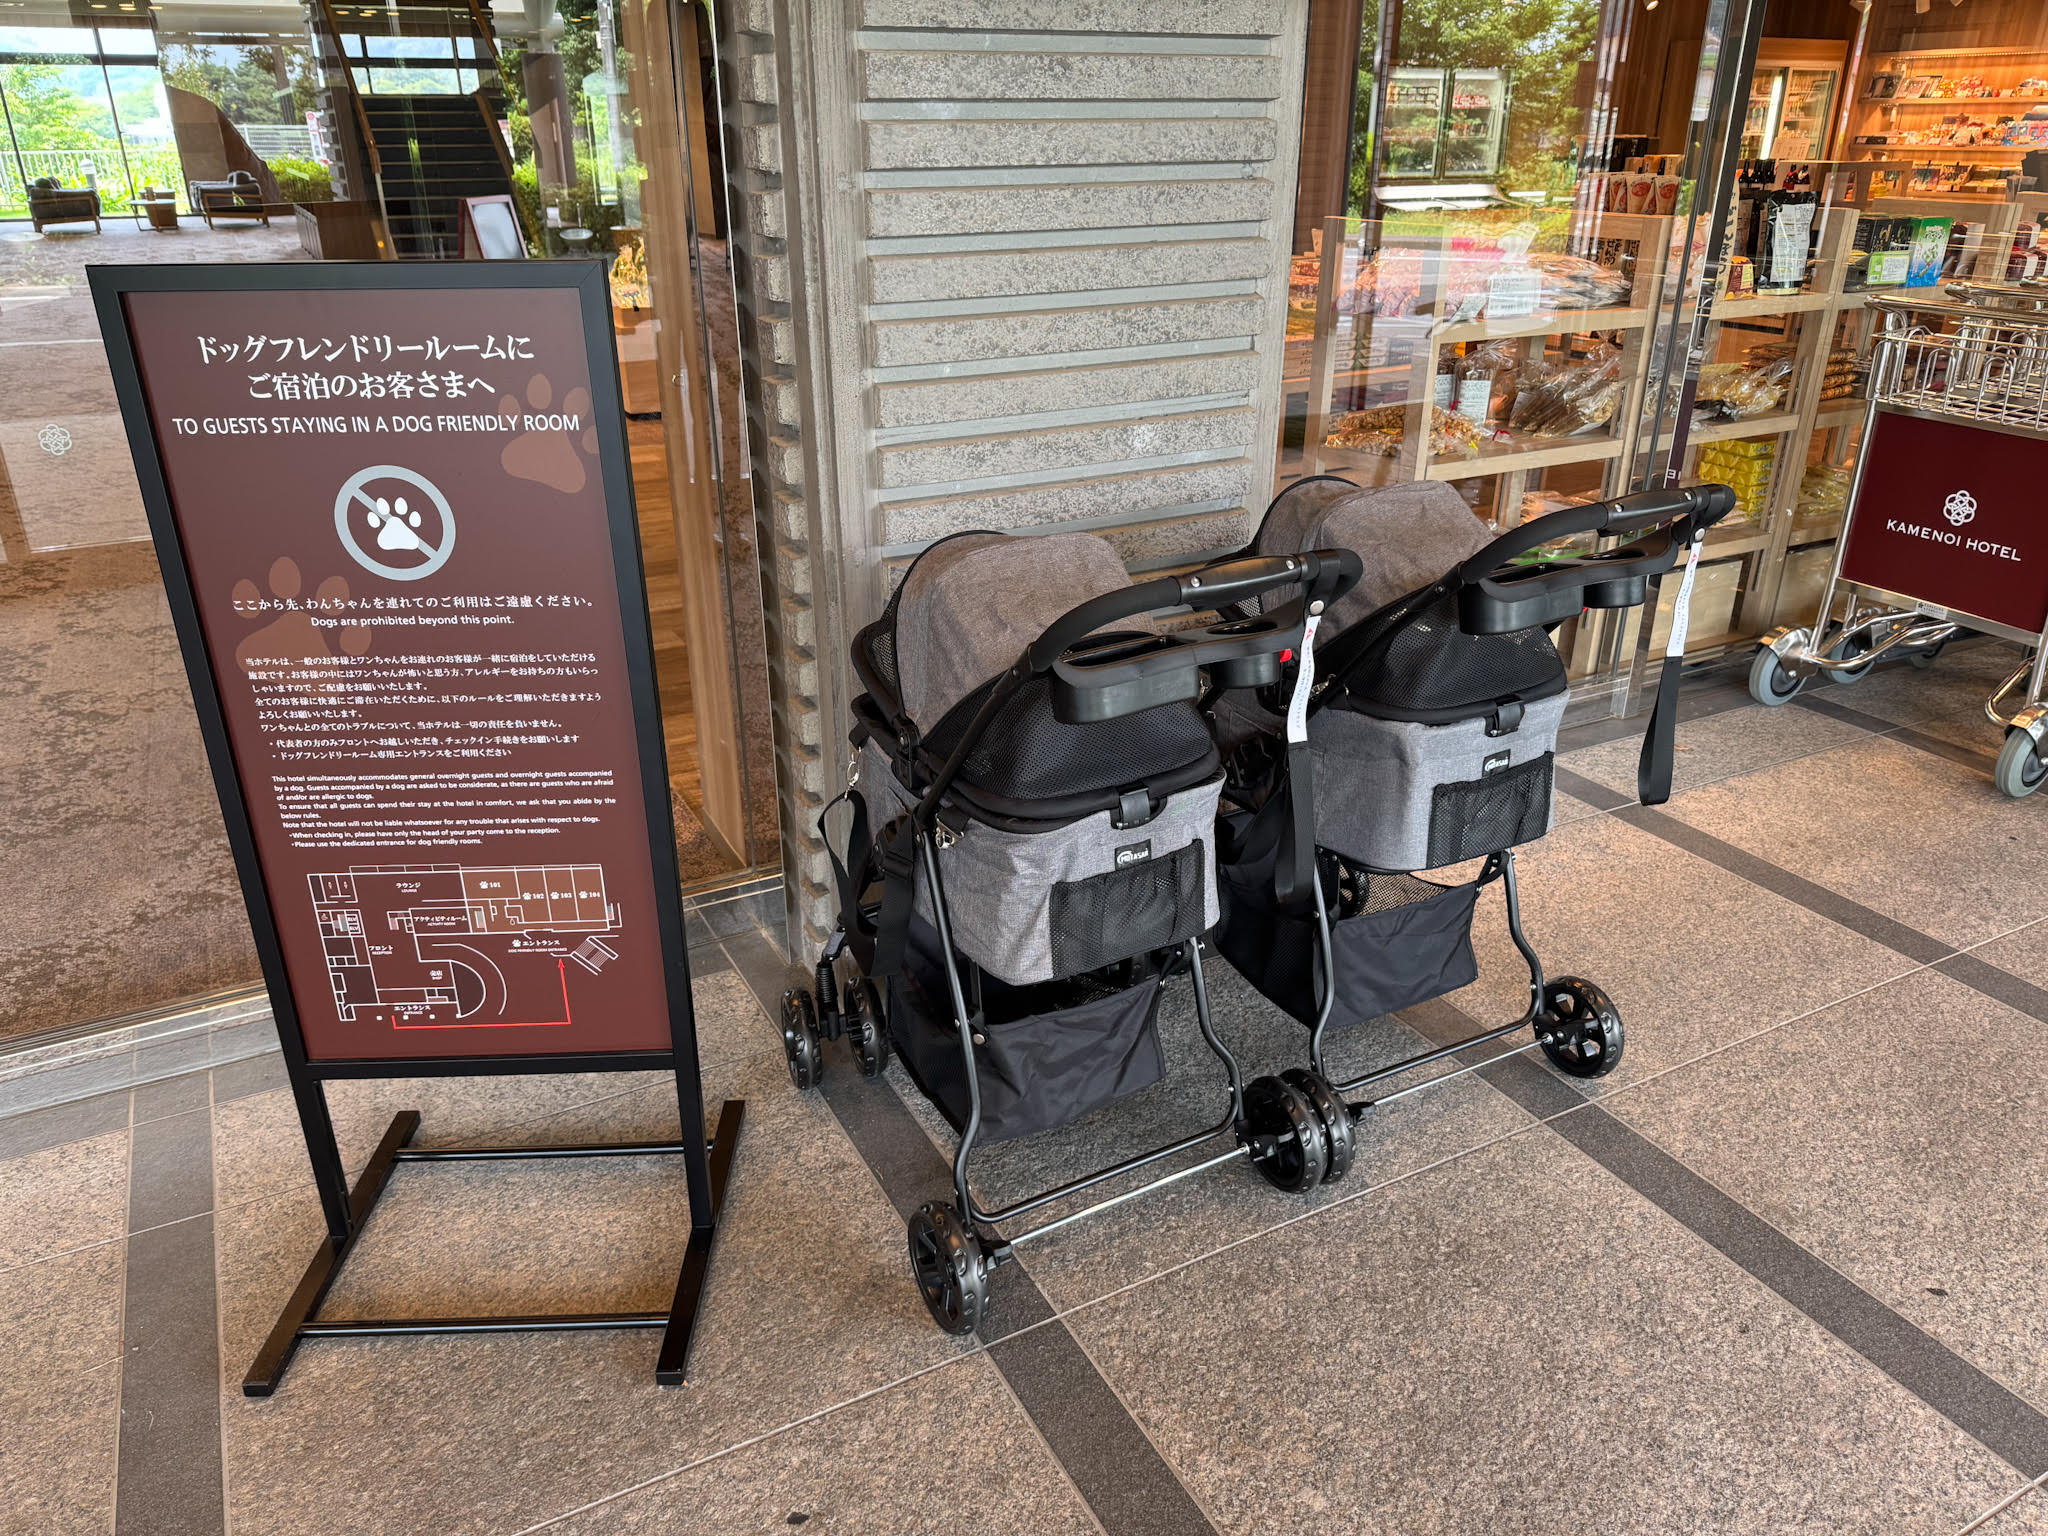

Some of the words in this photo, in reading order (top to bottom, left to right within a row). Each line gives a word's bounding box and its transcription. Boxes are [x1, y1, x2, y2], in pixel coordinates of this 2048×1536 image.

[197, 334, 535, 364] ドッグフレンドリールームに
[247, 371, 496, 400] ご宿泊のお客さまへ
[171, 417, 199, 435] TO
[202, 416, 268, 435] GUESTS
[270, 415, 348, 434] STAYING
[350, 415, 370, 433] IN
[375, 415, 389, 433] A
[391, 414, 433, 433] DOG
[436, 414, 519, 432] FRIENDLY
[522, 413, 580, 432] ROOM
[1886, 518, 1962, 547] KAMENOI
[1965, 537, 2022, 562] HOTEL
[232, 595, 593, 611] ここから先、わんちゃんを連れてのご利用はご遠慮ください。
[310, 616, 338, 629] Dogs
[339, 617, 358, 626] are
[359, 615, 416, 628] prohibited
[417, 614, 458, 627] beyond
[459, 614, 481, 625] this
[482, 614, 515, 626] point.
[258, 709, 363, 720] よろしくお願いいたします。
[286, 774, 306, 782] hotel
[305, 774, 357, 783] simultaneously
[357, 773, 409, 781] accommodates
[408, 772, 436, 782] general
[436, 771, 470, 781] overnight
[470, 772, 494, 780] guests
[494, 771, 509, 779] and
[509, 770, 544, 779] overnight
[543, 770, 567, 779] guests
[567, 769, 613, 778] accompanied
[330, 782, 375, 792] accompanied
[390, 782, 406, 791] dog
[418, 781, 439, 789] asked
[508, 780, 528, 788] there
[540, 780, 564, 788] guests
[592, 778, 614, 786] afraid
[285, 793, 308, 801] and/or
[320, 792, 346, 802] allergic
[312, 802, 328, 810] that
[338, 802, 362, 811] guests
[376, 800, 398, 810] spend
[398, 800, 416, 808] their
[416, 801, 432, 809] stay
[455, 799, 475, 807] hotel
[528, 798, 541, 806] ask
[541, 797, 557, 805] that
[572, 797, 593, 805] abide
[603, 796, 617, 804] the
[279, 812, 302, 820] below
[281, 821, 300, 829] Note
[299, 820, 316, 828] that
[315, 820, 328, 828] the
[327, 820, 347, 828] hotel
[383, 819, 403, 827] liable
[403, 818, 443, 826] whatsoever
[442, 818, 454, 826] for
[468, 817, 494, 825] trouble
[510, 816, 530, 824] arises
[529, 816, 547, 824] with
[546, 816, 573, 824] respect
[313, 831, 344, 839] checking
[353, 830, 376, 839] please
[393, 829, 409, 838] only
[408, 829, 422, 837] the
[421, 829, 440, 837] head
[448, 829, 466, 837] your
[465, 828, 485, 836] party
[341, 839, 376, 847] dedicated
[375, 839, 406, 847] entrance
[405, 838, 417, 846] for
[417, 838, 432, 847] dog
[431, 837, 459, 846] friendly
